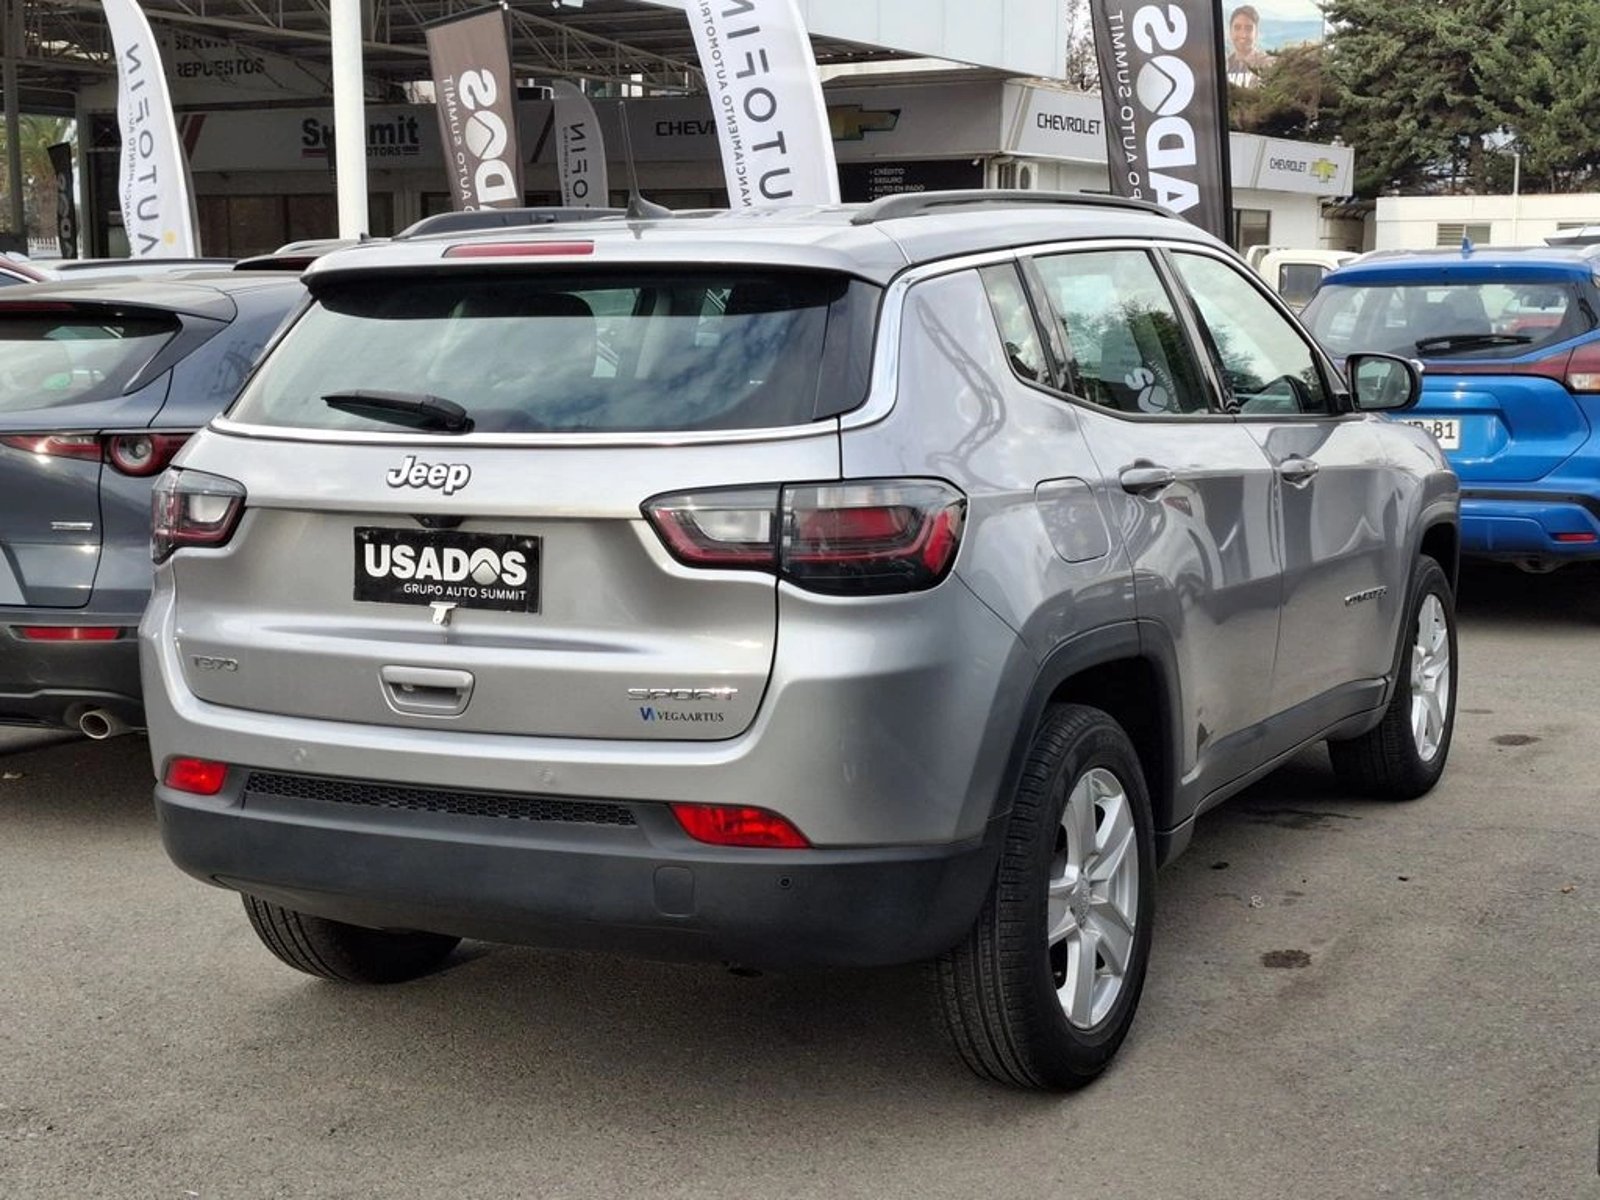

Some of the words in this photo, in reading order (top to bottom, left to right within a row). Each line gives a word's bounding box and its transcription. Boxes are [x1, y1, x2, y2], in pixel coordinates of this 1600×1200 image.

[302, 115, 420, 147] Sumit
[1037, 112, 1101, 135] CHEVROLET
[1269, 157, 1307, 173] CHEVROLET
[386, 455, 471, 496] Jeep
[365, 543, 528, 586] USADOS
[403, 583, 443, 595] GRUPO
[446, 587, 478, 598] AUTO
[481, 588, 527, 601] SUMMIT
[627, 688, 738, 701] SPORT
[658, 711, 724, 722] VEGAARTUS
